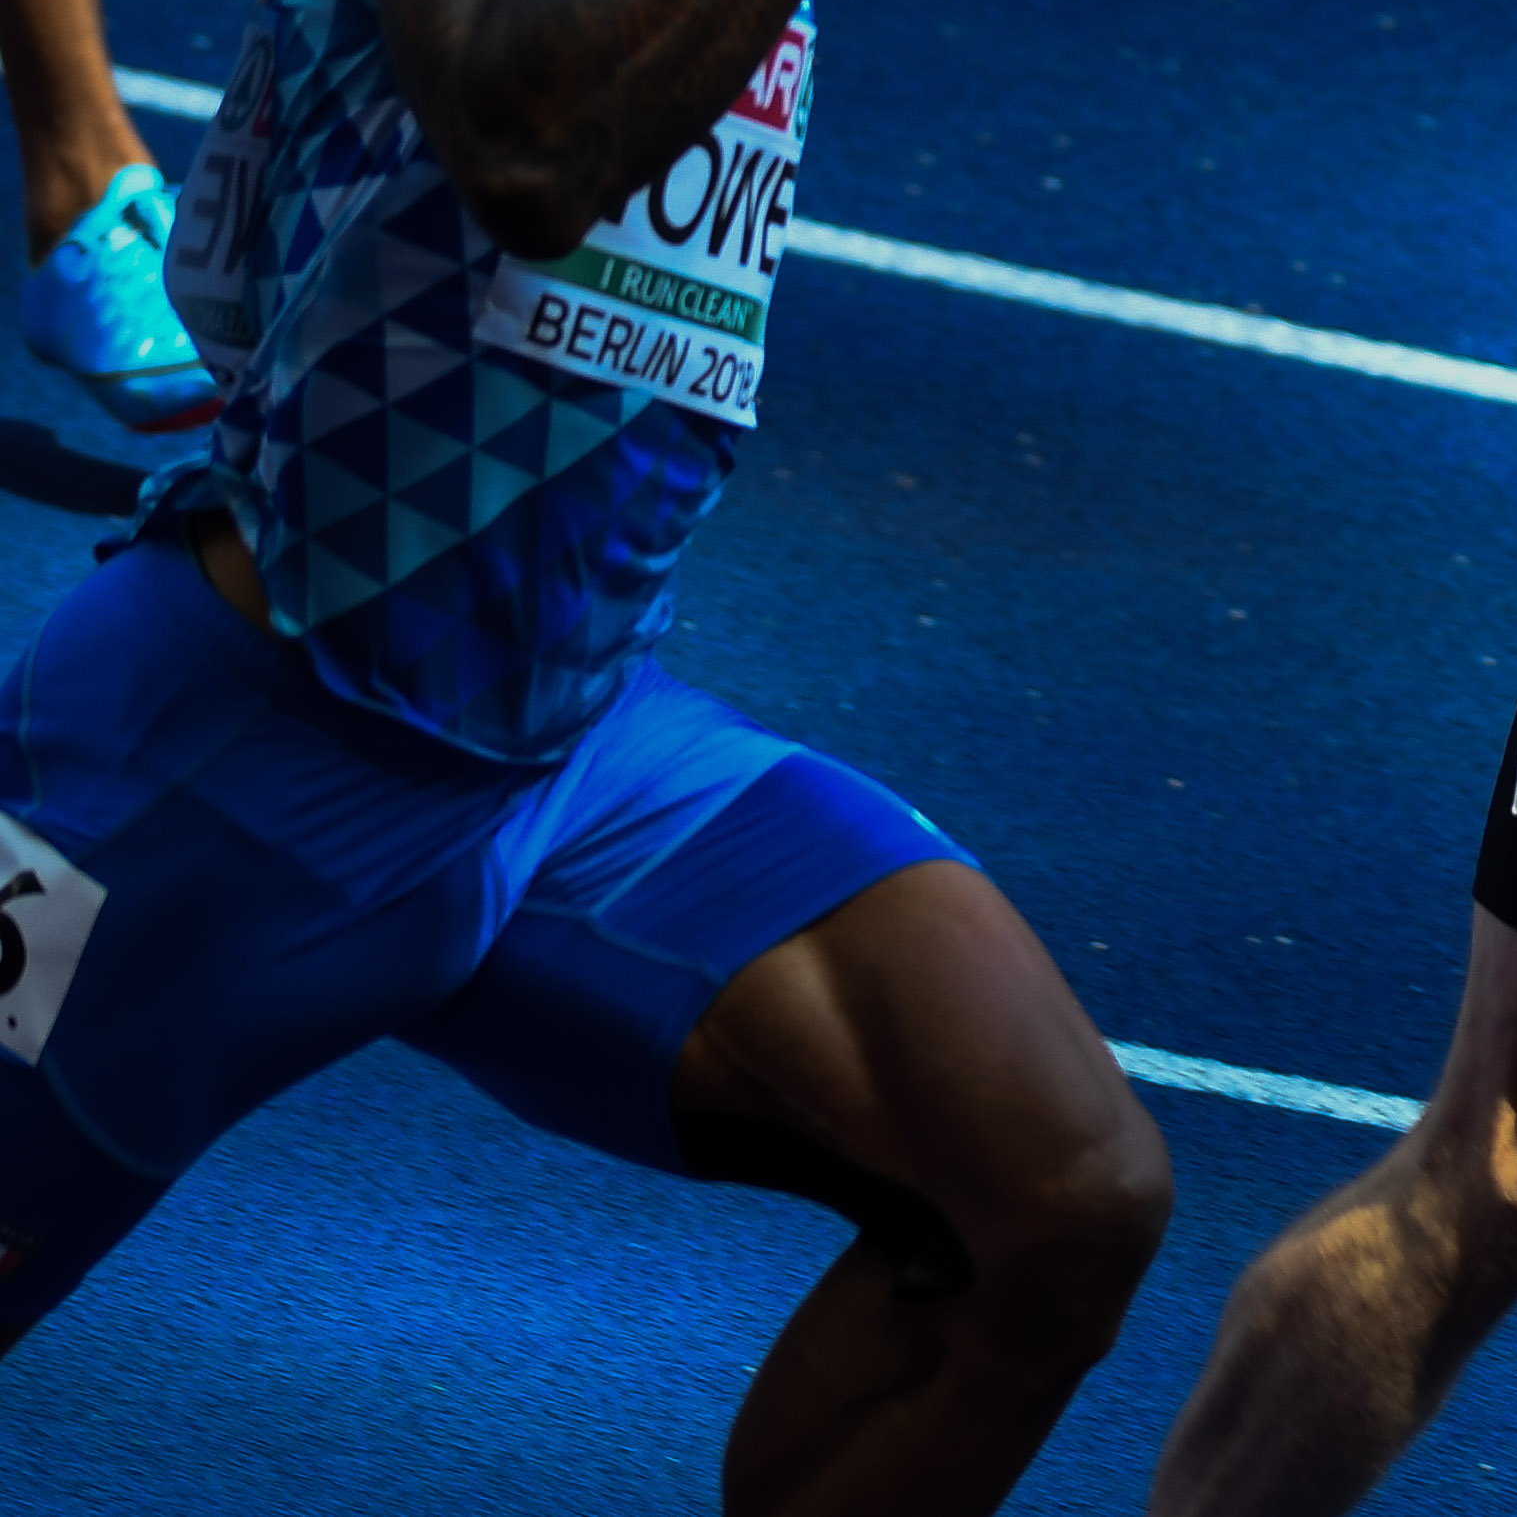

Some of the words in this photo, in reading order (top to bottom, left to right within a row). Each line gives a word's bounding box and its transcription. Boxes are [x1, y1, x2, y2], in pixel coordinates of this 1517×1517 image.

[600, 257, 616, 291] I
[619, 262, 681, 311] RUN
[526, 292, 692, 388] BERLIN
